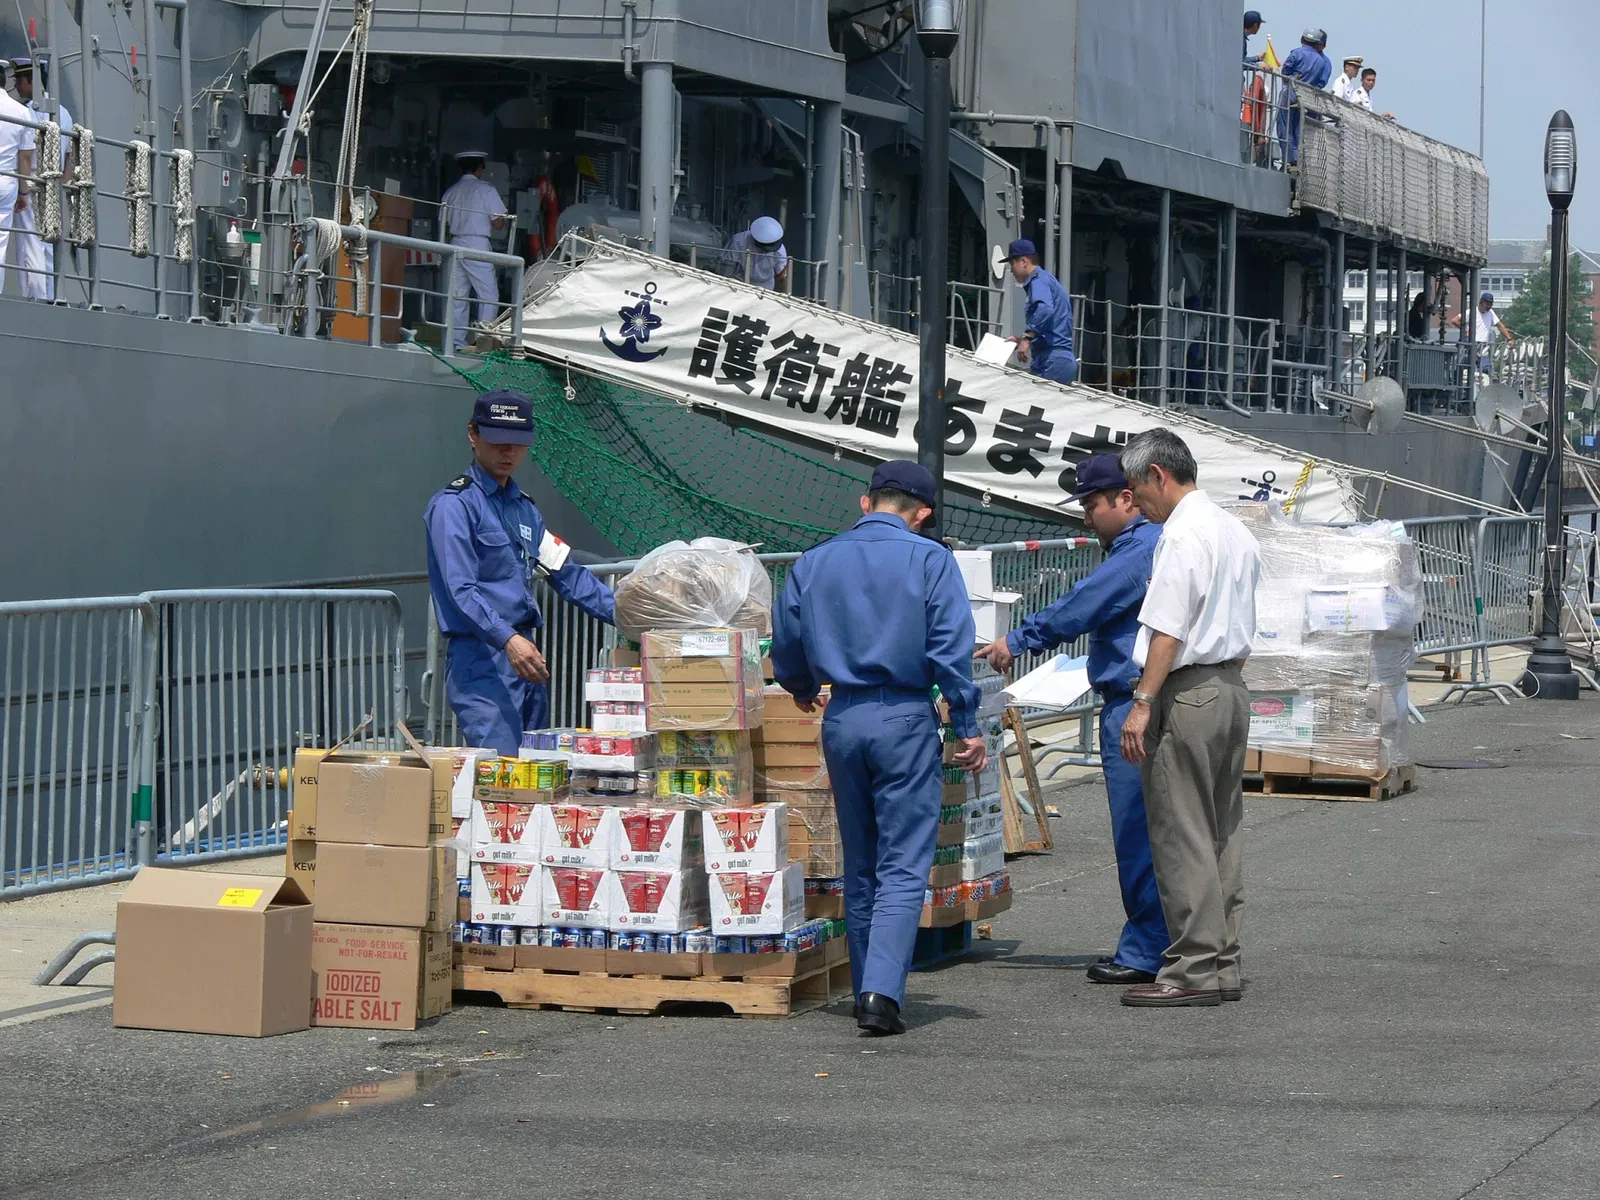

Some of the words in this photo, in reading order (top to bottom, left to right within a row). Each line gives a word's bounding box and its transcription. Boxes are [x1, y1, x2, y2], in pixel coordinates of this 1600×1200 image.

[501, 851, 517, 860] milk?
[562, 855, 570, 864] got
[571, 856, 586, 864] milk?
[635, 854, 643, 864] got
[644, 854, 659, 864] milk?
[728, 860, 736, 869] got
[737, 859, 752, 868] milk?
[500, 912, 516, 921] milk?
[746, 916, 761, 925] milk?
[345, 939, 367, 949] FOOD
[370, 940, 404, 949] SERVICE
[326, 973, 381, 993] IODIZED
[311, 998, 355, 1019] ABLE
[360, 1000, 402, 1022] SALT
